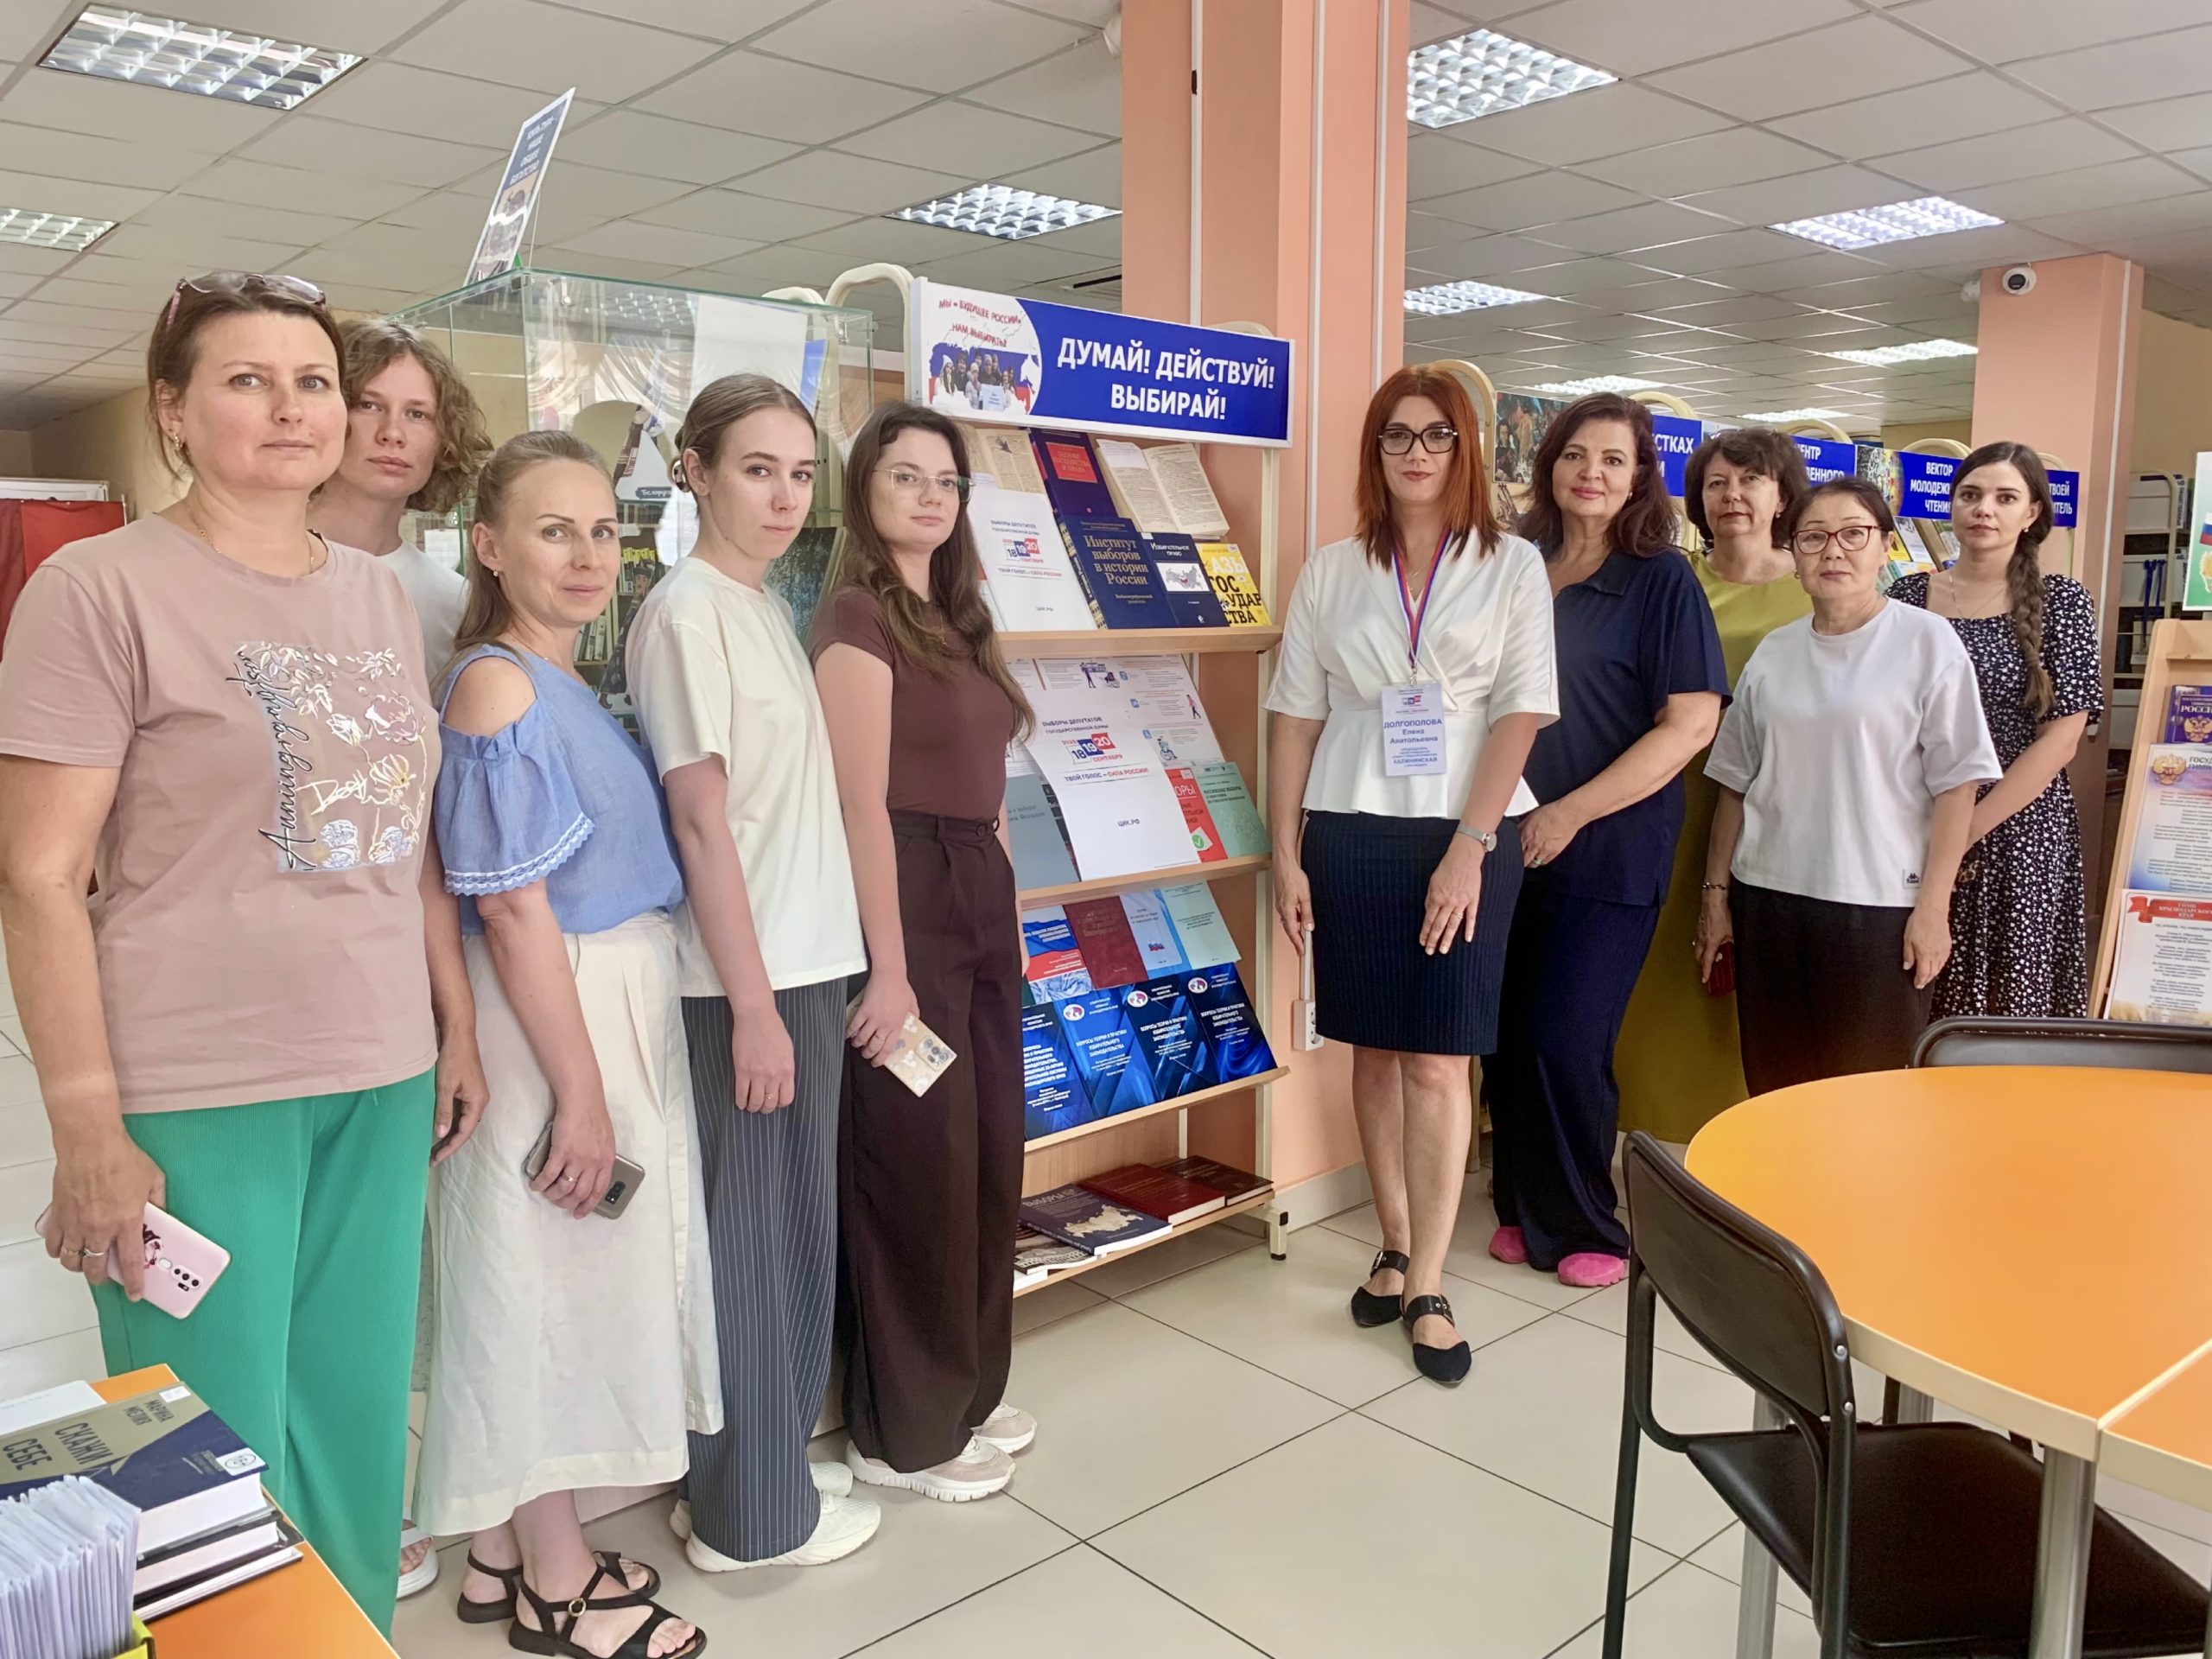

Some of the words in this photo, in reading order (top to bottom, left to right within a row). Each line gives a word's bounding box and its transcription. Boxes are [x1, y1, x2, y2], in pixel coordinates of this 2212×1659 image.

[939, 299, 951, 308] МЫ
[959, 300, 989, 319] БУДУЩЕЕ
[952, 323, 969, 334] НАМ
[1057, 338, 1151, 373] ДУМАЙ!
[1155, 347, 1274, 389] ДЕЙСТВУЙ!
[1111, 384, 1226, 419] ВЫБИРАЙ!
[1652, 433, 1694, 454] СТКАХ
[1796, 443, 1821, 461] ЕНТР
[1926, 461, 1953, 476] ВЕКТОР
[2049, 480, 2069, 496] ТВОЕЙ
[1007, 548, 1017, 557] 18
[1016, 543, 1027, 554] 19
[1026, 541, 1037, 551] 20
[1084, 535, 1137, 551] Институт
[1092, 548, 1141, 563] выборов
[1094, 563, 1102, 572] в
[1103, 563, 1148, 575] истории
[1105, 572, 1147, 585] России
[1226, 594, 1262, 609] УДАР
[1042, 718, 1069, 728] ВЫБОРЫ
[1069, 716, 1103, 725] ДЕПУТАТОВ
[1046, 726, 1093, 734] ГОСУДАРСТВЕННОЙ
[1384, 719, 1442, 728] ДОЛГОПОЛОВА
[1071, 749, 1087, 760] 18
[1082, 742, 1096, 753] 19
[1094, 736, 1111, 747] 20
[1117, 818, 1140, 827] ЦИК.РФ
[123, 1405, 153, 1426] МЕЛИЯ
[144, 1399, 175, 1423] МАРИНА
[54, 1422, 114, 1465] СКАЖИ
[3, 1438, 53, 1471] СЕБЕ
